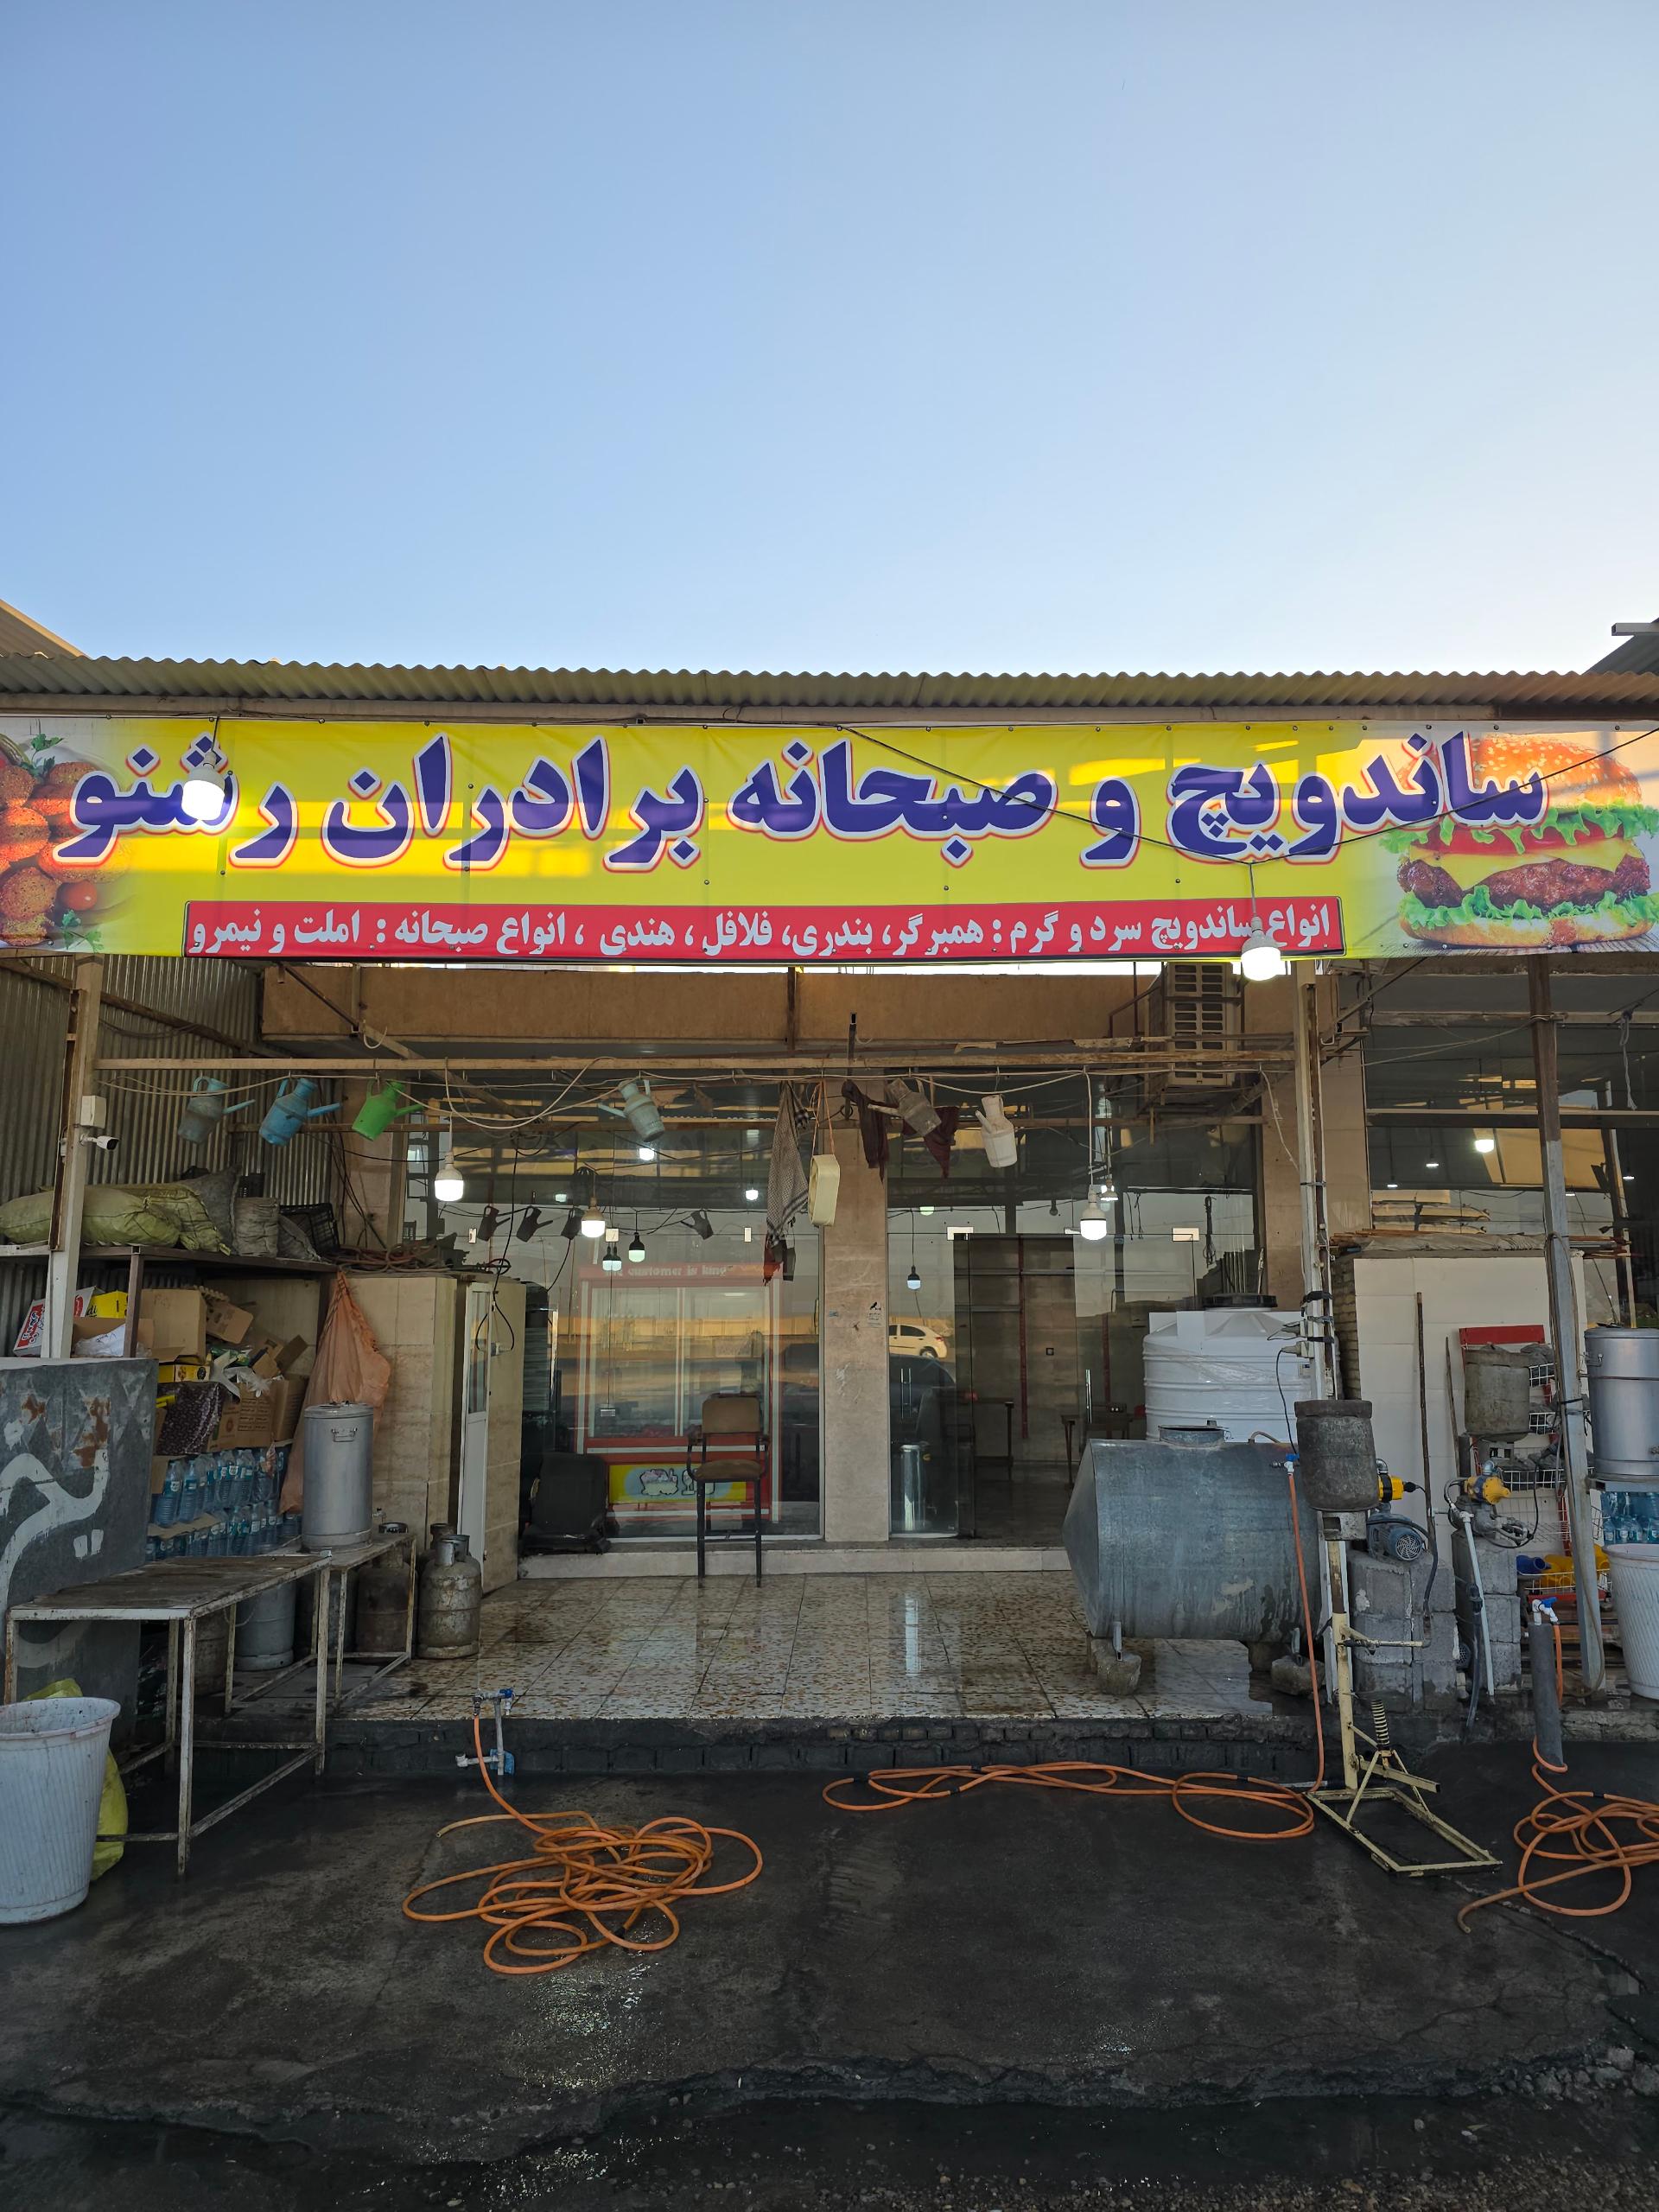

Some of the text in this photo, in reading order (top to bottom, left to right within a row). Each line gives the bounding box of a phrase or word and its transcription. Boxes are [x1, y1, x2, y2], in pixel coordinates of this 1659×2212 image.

[321, 733, 707, 870] برادران
[728, 738, 1060, 867] صبحانه
[1165, 730, 1548, 863] ساندویچ
[1078, 774, 1142, 868] و
[190, 909, 261, 953] نیمرو
[270, 925, 284, 953] و
[295, 910, 359, 944] املت
[395, 911, 487, 952] صبحانه
[497, 912, 565, 955] انواع
[601, 915, 675, 957] هندی
[702, 911, 772, 956] فلافل
[1010, 909, 1059, 953] گرم
[1070, 924, 1083, 953] و
[1090, 918, 1141, 952] سرد
[1150, 905, 1255, 951] ساندویچ
[1265, 903, 1330, 948] انواع
[627, 1265, 682, 1276] customer
